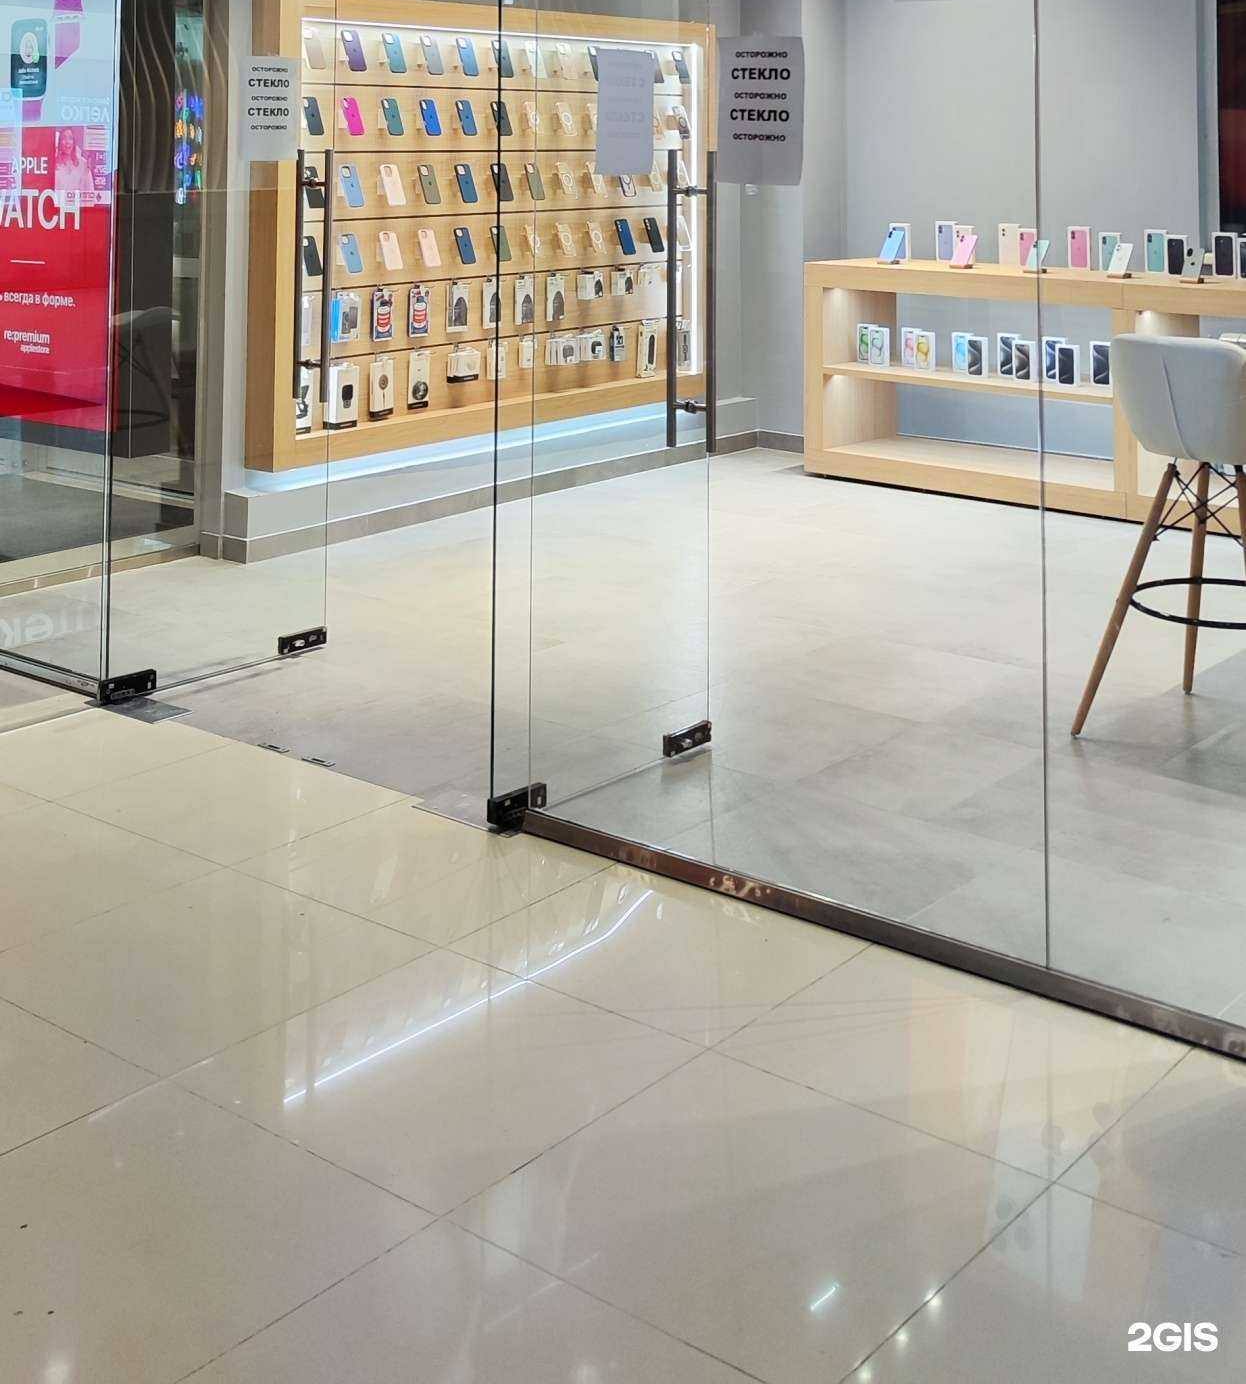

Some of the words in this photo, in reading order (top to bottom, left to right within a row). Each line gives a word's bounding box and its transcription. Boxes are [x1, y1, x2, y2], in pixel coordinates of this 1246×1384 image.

[735, 50, 789, 59] ОСТОРОЖНО
[731, 67, 791, 81] СТЕКЛО
[247, 78, 290, 88] СТЕКЛО
[733, 91, 788, 101] ОСТОРОЖНО
[247, 107, 290, 117] СТЕКЛО
[729, 108, 790, 122] СТЕКЛО
[732, 132, 787, 142] ОСТОРОЖНО
[12, 156, 49, 175] APPLE
[3, 292, 34, 306] всегда
[35, 294, 41, 305] в
[42, 292, 76, 309] форме.
[3, 329, 51, 345] re:premium
